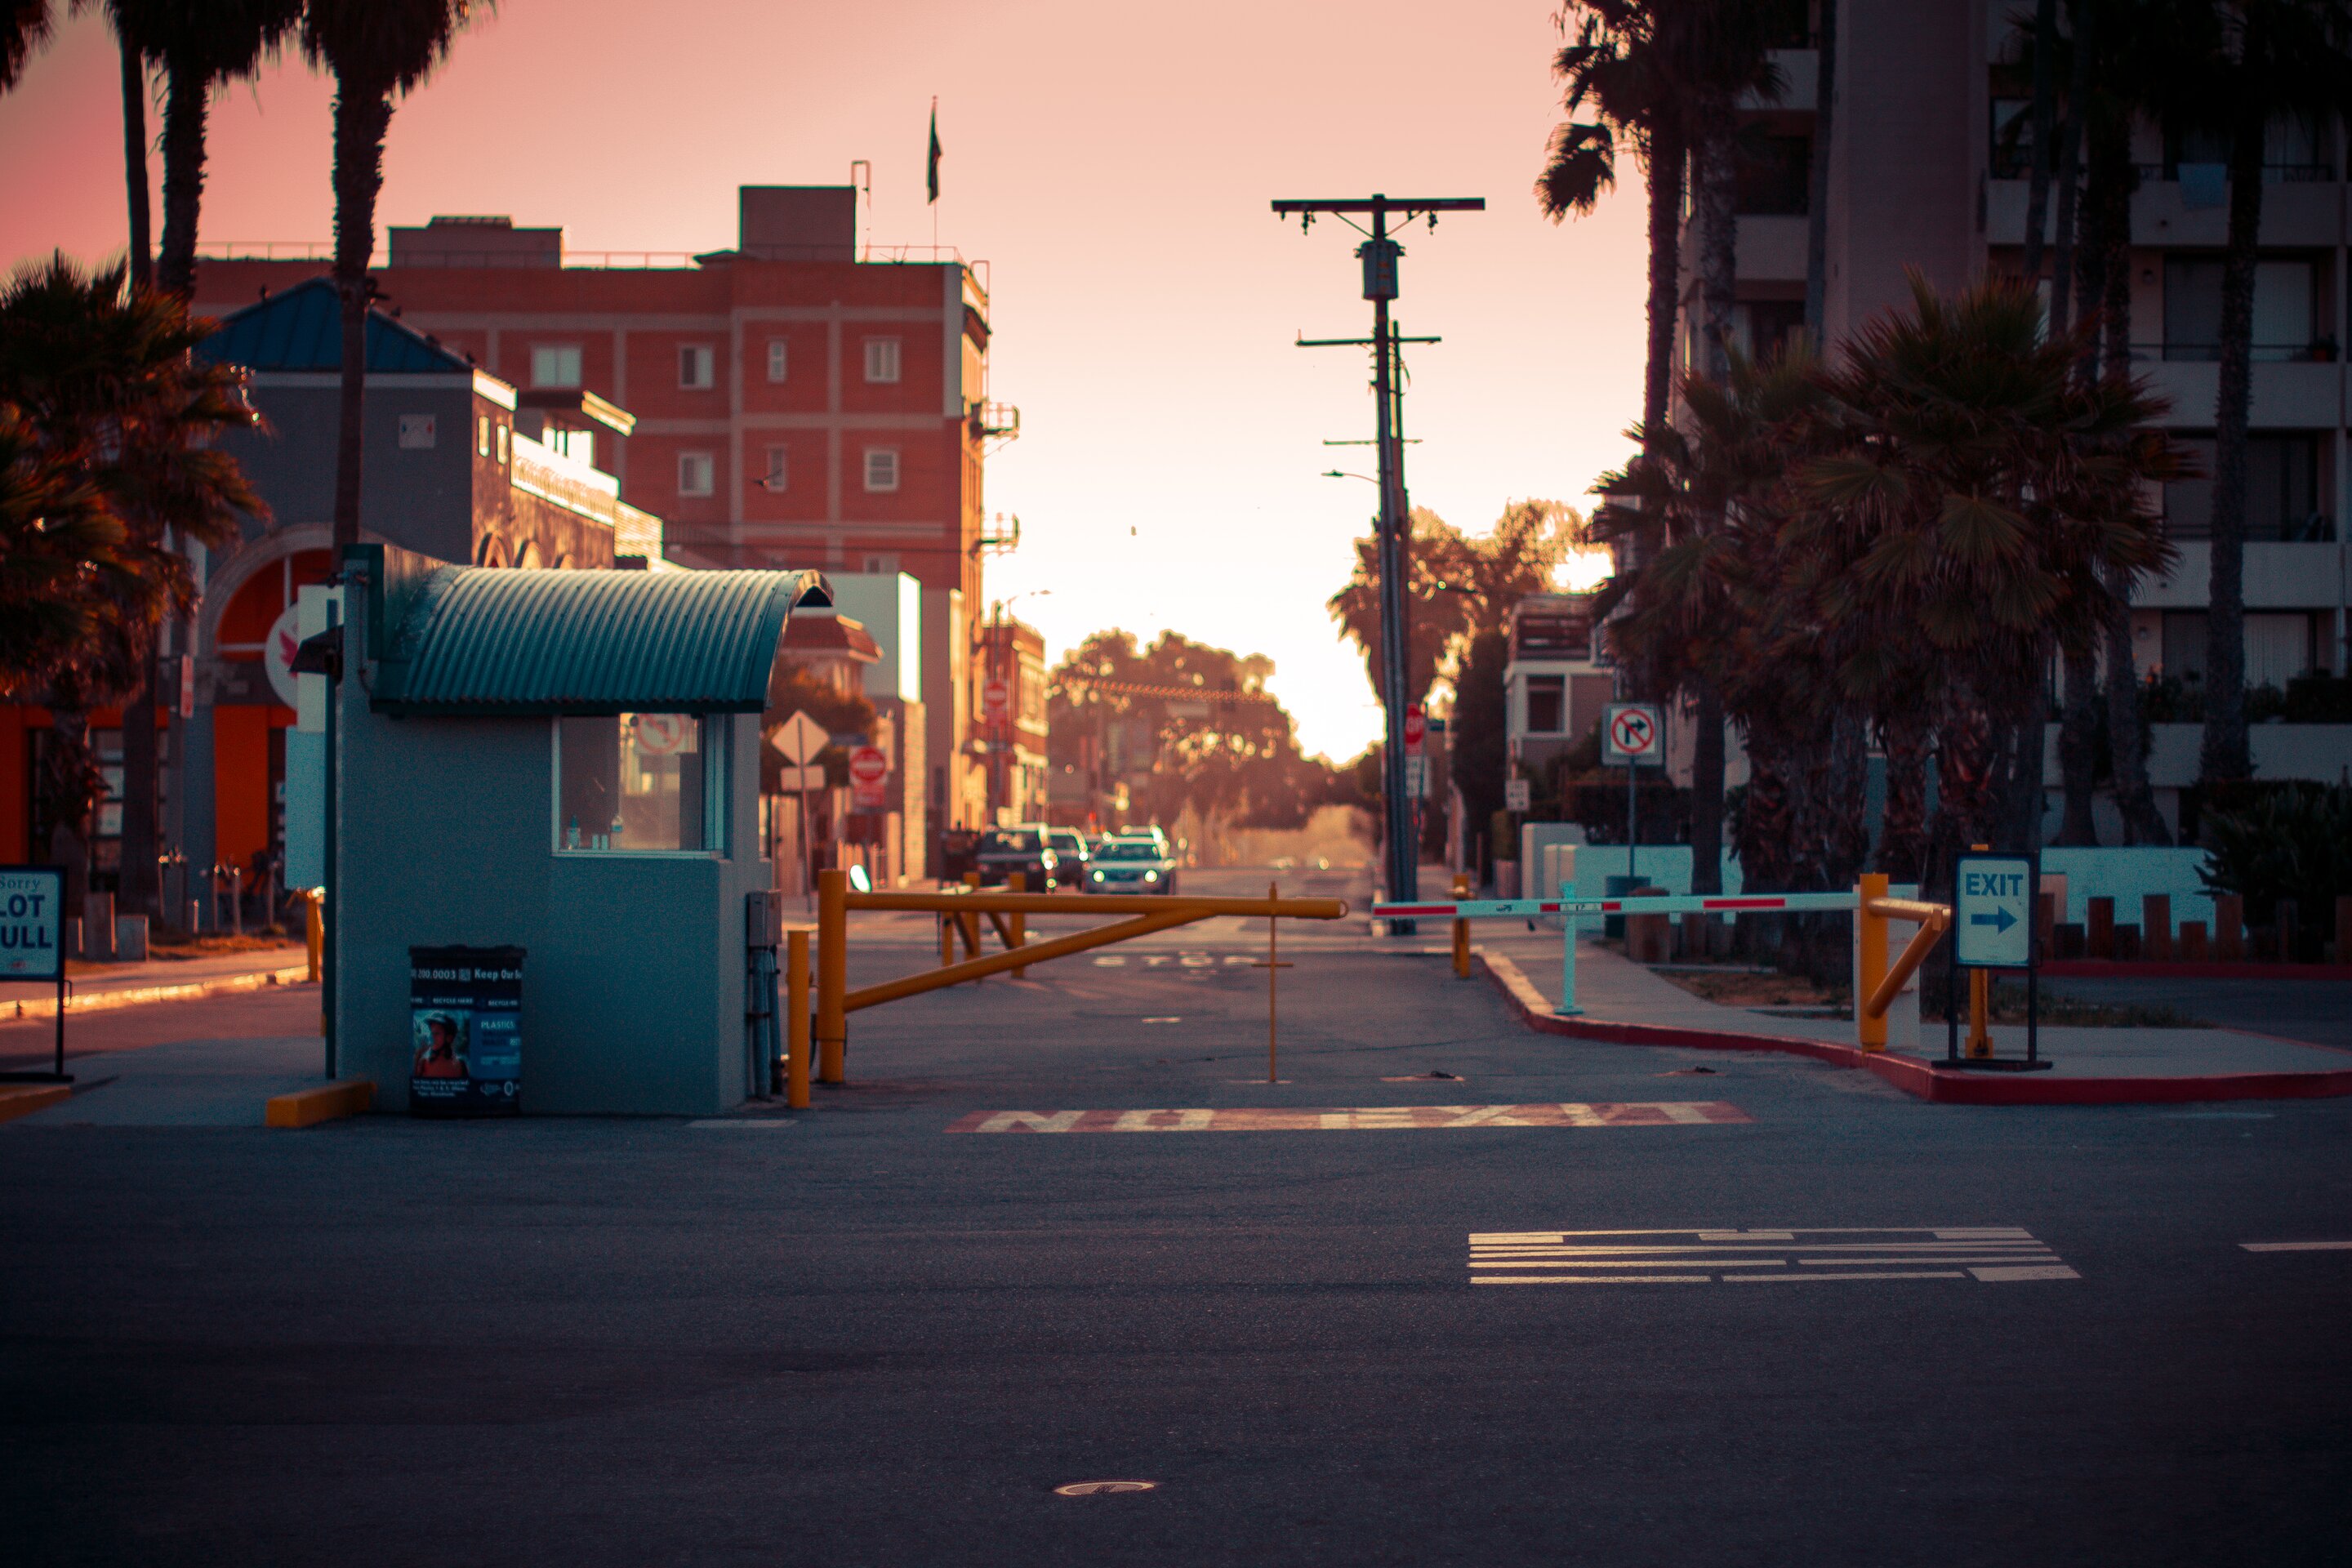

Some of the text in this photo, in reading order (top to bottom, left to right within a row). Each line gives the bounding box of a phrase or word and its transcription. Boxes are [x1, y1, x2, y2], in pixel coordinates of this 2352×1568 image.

[1965, 873, 2024, 897] EXIT
[0, 925, 52, 948] ULL
[474, 968, 498, 982] Keep
[973, 1101, 1718, 1133] NO EXIT
